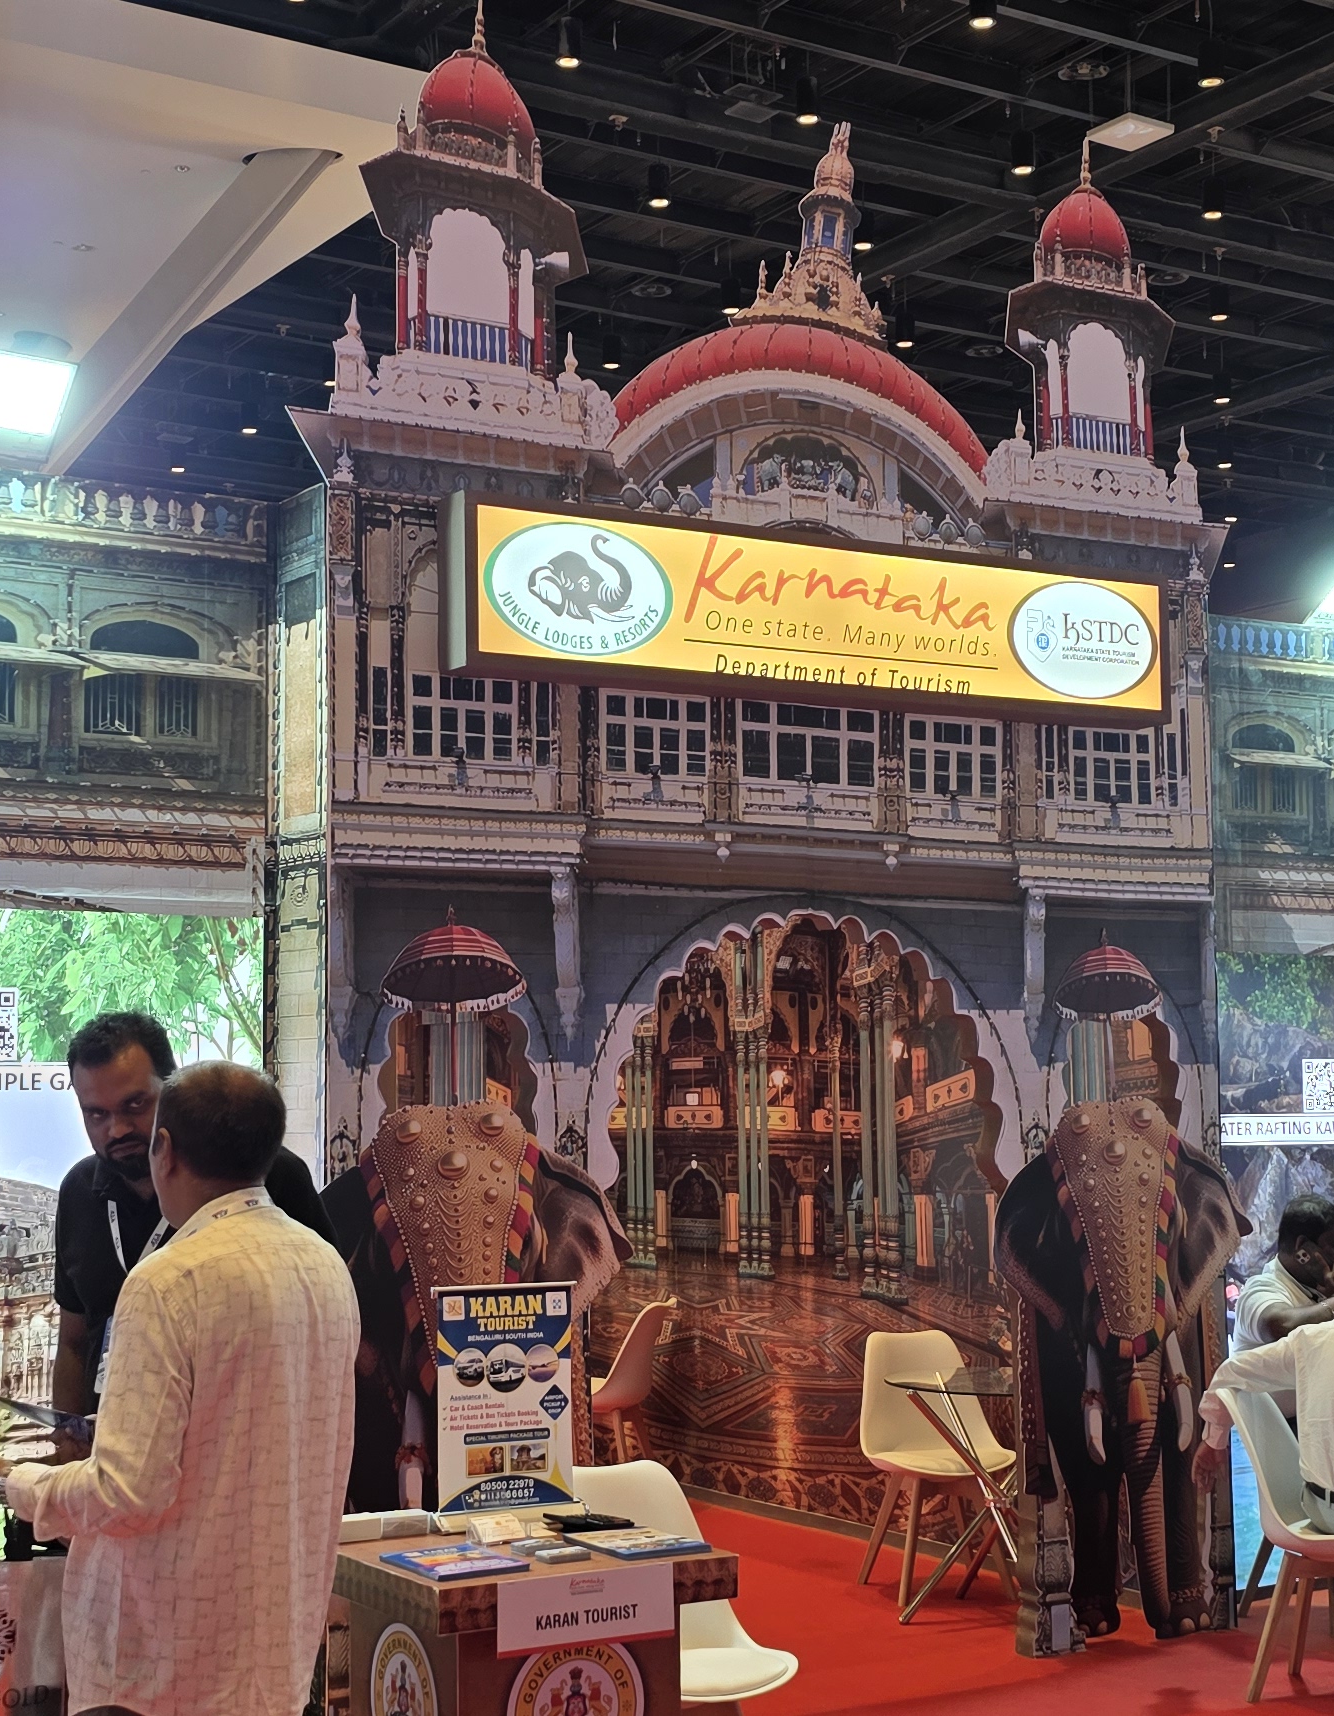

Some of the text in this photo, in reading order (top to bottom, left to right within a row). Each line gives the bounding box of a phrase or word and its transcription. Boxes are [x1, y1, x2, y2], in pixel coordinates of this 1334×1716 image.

[683, 535, 998, 632] Karnataka
[499, 591, 659, 650] JUNGLE LODGES & RESORTS
[705, 610, 998, 658] One state. Many worlds.
[1102, 656, 1140, 666] CORPORATION
[716, 653, 971, 695] Department of Tourism
[1221, 1121, 1252, 1137] ATER
[1256, 1120, 1312, 1136] RAFTING
[469, 1294, 544, 1318] KARAN
[477, 1315, 536, 1332] TOURIST
[468, 1331, 544, 1342] BENGALURU SOUTH INDIA
[459, 1412, 479, 1421] Tickets
[497, 1410, 516, 1419] Tickets
[517, 1409, 539, 1418] Booking
[467, 1402, 484, 1411] Coach
[466, 1422, 497, 1430] Reservation
[504, 1419, 518, 1428] Tours
[520, 1418, 543, 1427] Package
[536, 1603, 639, 1631] KARAN TOURIST
[378, 1637, 430, 1697] GOVERNMENT OF
[523, 1644, 629, 1704] GOVERNMENT OF
